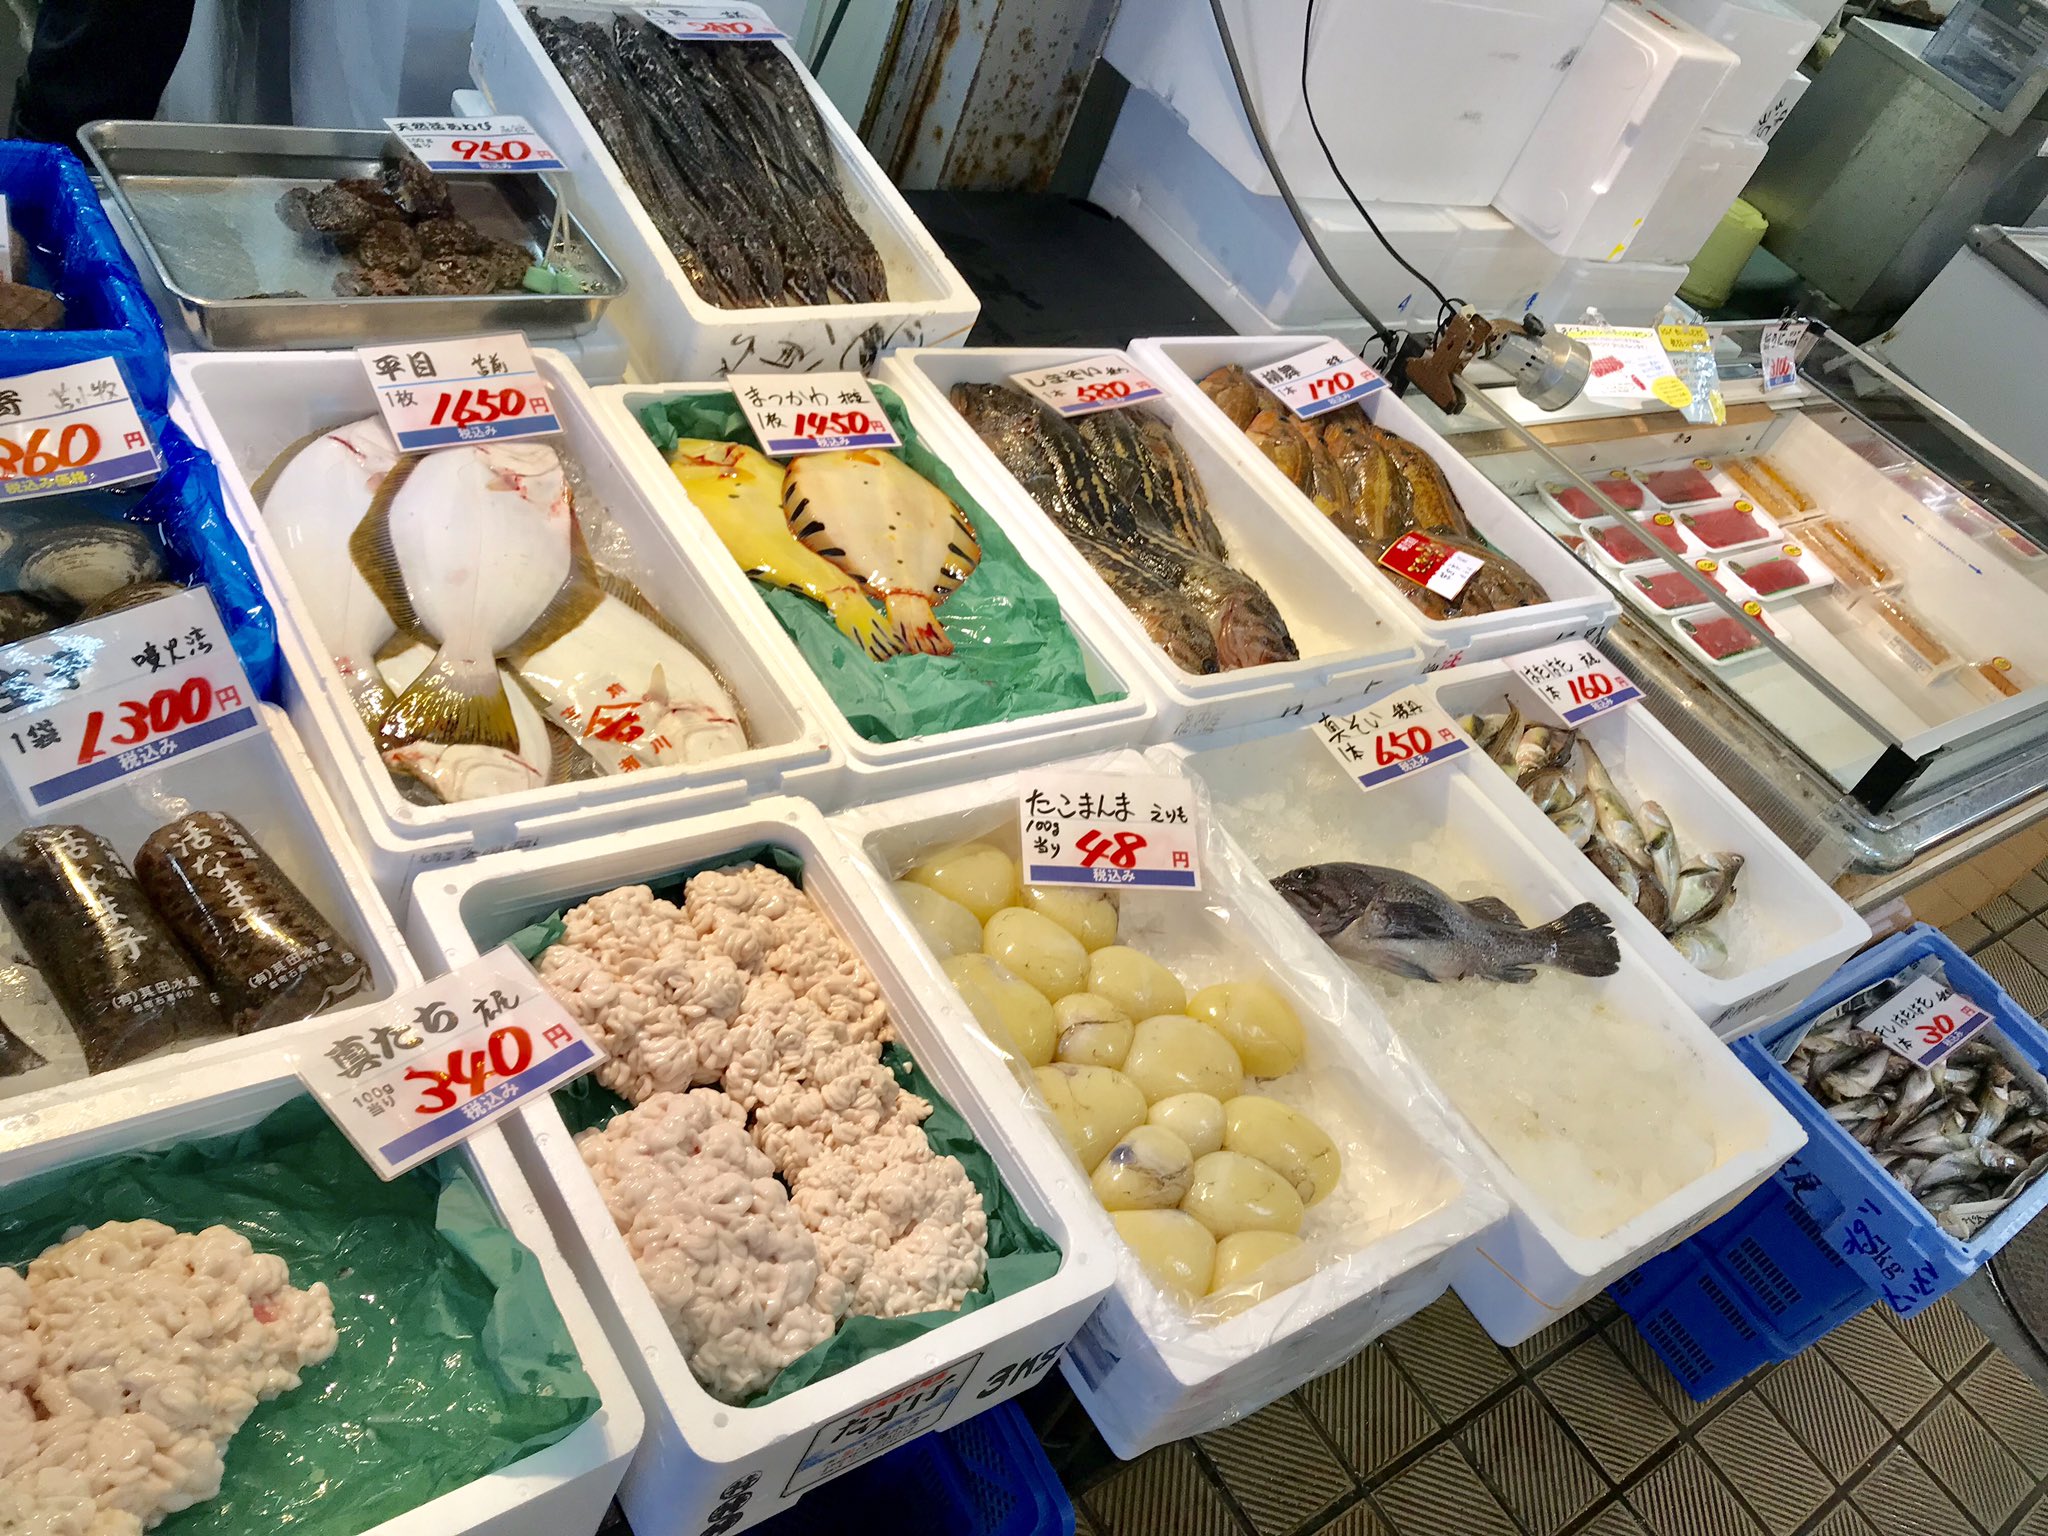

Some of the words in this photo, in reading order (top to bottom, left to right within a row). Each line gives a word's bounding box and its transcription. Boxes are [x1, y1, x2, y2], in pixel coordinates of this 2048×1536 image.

[451, 140, 531, 161] 950
[373, 351, 437, 381] 平目
[744, 386, 829, 408] まつかわ
[1078, 380, 1130, 402] 580
[1308, 372, 1355, 400] 170
[384, 389, 418, 408] 1枚
[529, 397, 550, 414] 円
[123, 431, 145, 450] 円
[457, 426, 498, 440] 税込み
[1519, 657, 1574, 684] はたはた
[1568, 673, 1613, 704] 160
[10, 719, 62, 754] 1袋
[214, 685, 242, 712] 円
[118, 738, 178, 772] 税込み
[1376, 726, 1432, 766] 650
[1438, 728, 1456, 742] 円
[1398, 755, 1430, 773] 税込み
[1026, 789, 1136, 822] たこまんま
[1150, 803, 1189, 824] えりも
[1026, 820, 1060, 837] 100g
[1034, 836, 1061, 859] 当り
[1075, 829, 1148, 869] 48
[1172, 851, 1190, 868] 円
[1092, 869, 1136, 883] 税込み
[324, 1001, 460, 1079] 真たち
[1914, 1014, 1955, 1045] 30
[366, 1094, 397, 1118] 当り
[404, 1026, 534, 1114] 340
[542, 1023, 574, 1050] 円
[352, 1083, 395, 1110] 100g
[462, 1080, 520, 1121] 税込み
